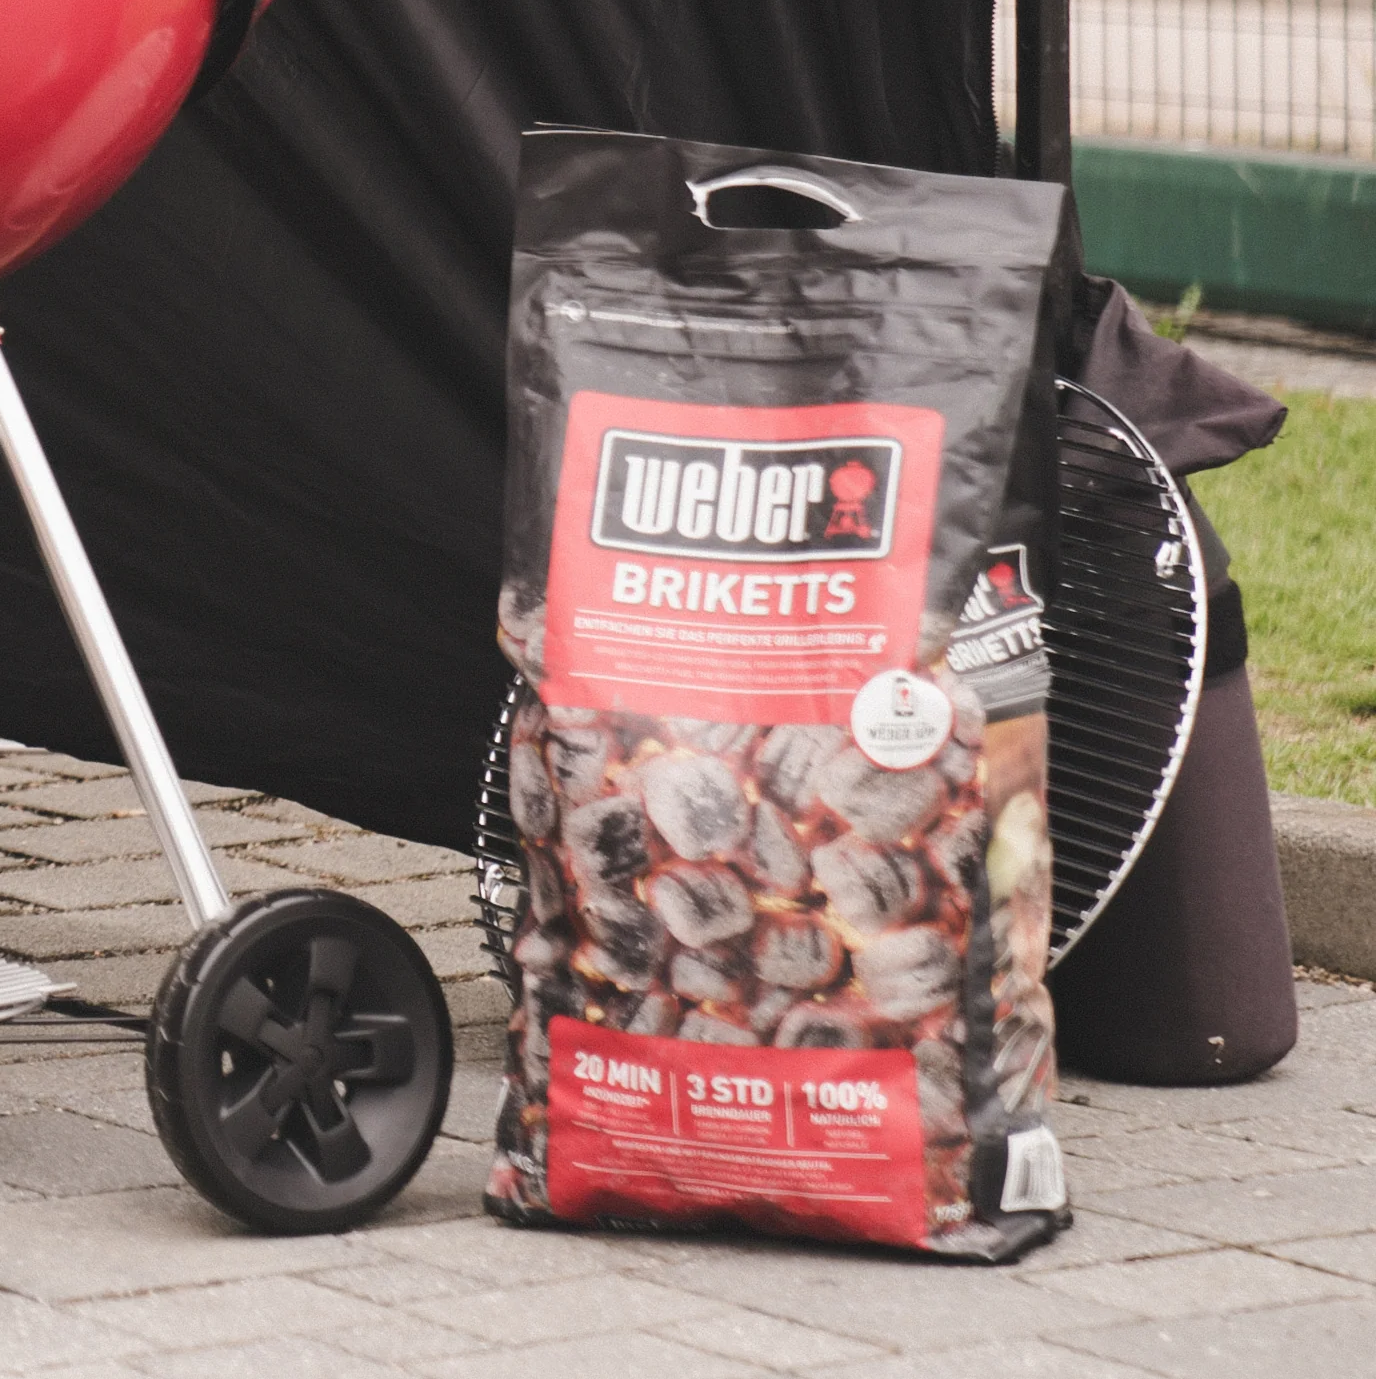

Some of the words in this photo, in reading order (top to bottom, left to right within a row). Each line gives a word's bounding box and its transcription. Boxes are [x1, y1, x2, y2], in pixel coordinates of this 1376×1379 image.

[621, 445, 825, 544] weber
[611, 561, 856, 616] BRIKETTS
[573, 1051, 604, 1082] 20
[606, 1058, 662, 1095] MIN
[686, 1073, 708, 1101] 3
[710, 1077, 774, 1107] STD
[801, 1081, 888, 1111] 100%
